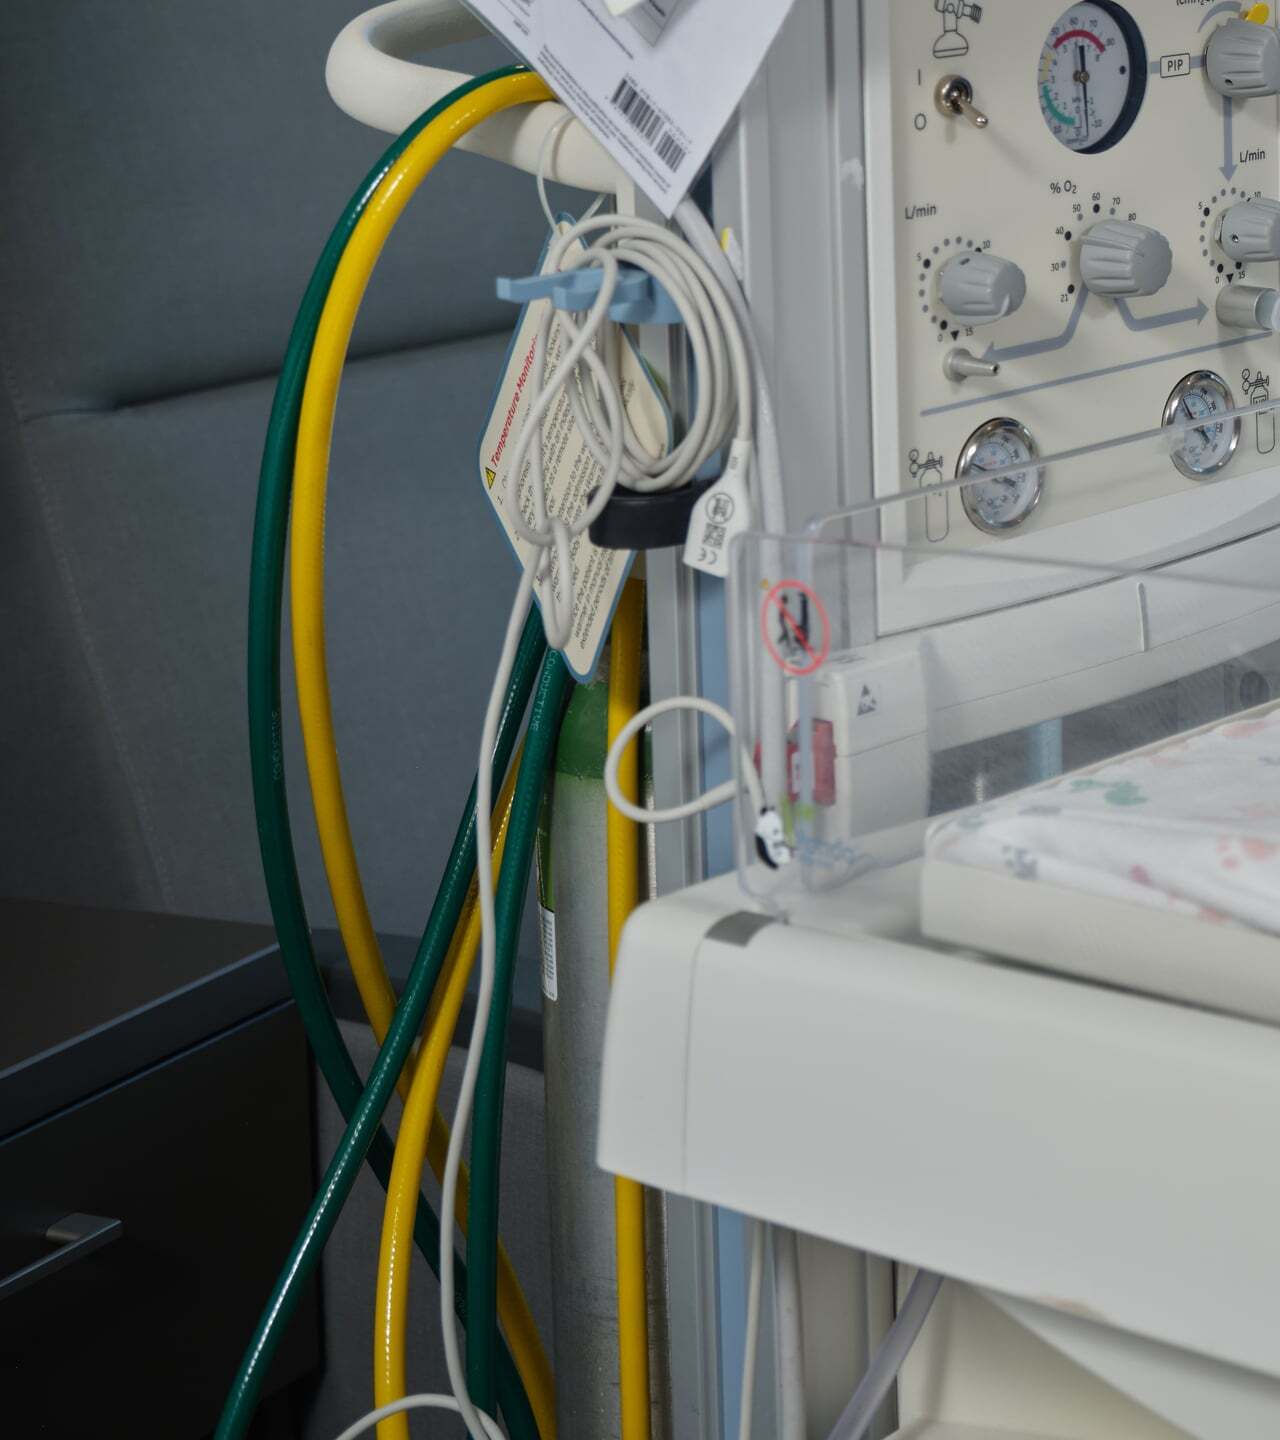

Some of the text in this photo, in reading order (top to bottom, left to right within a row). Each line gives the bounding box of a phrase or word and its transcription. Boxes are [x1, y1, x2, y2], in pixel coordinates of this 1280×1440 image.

[1167, 59, 1184, 75] PIP
[1239, 149, 1266, 163] L/min
[1050, 182, 1061, 194] %
[1091, 192, 1100, 201] 60
[1112, 197, 1120, 206] 70
[1072, 204, 1082, 213] 50
[1198, 201, 1203, 210] 5
[904, 204, 937, 220] L/min
[1128, 212, 1137, 222] 80
[1055, 226, 1064, 235] 40
[982, 240, 992, 250] 10
[1050, 262, 1060, 272] 30
[1238, 270, 1246, 280] 15
[1060, 293, 1069, 303] 21
[965, 327, 974, 337] 15
[491, 394, 520, 466] Temperature
[532, 648, 560, 731] CONDUCTIVE
